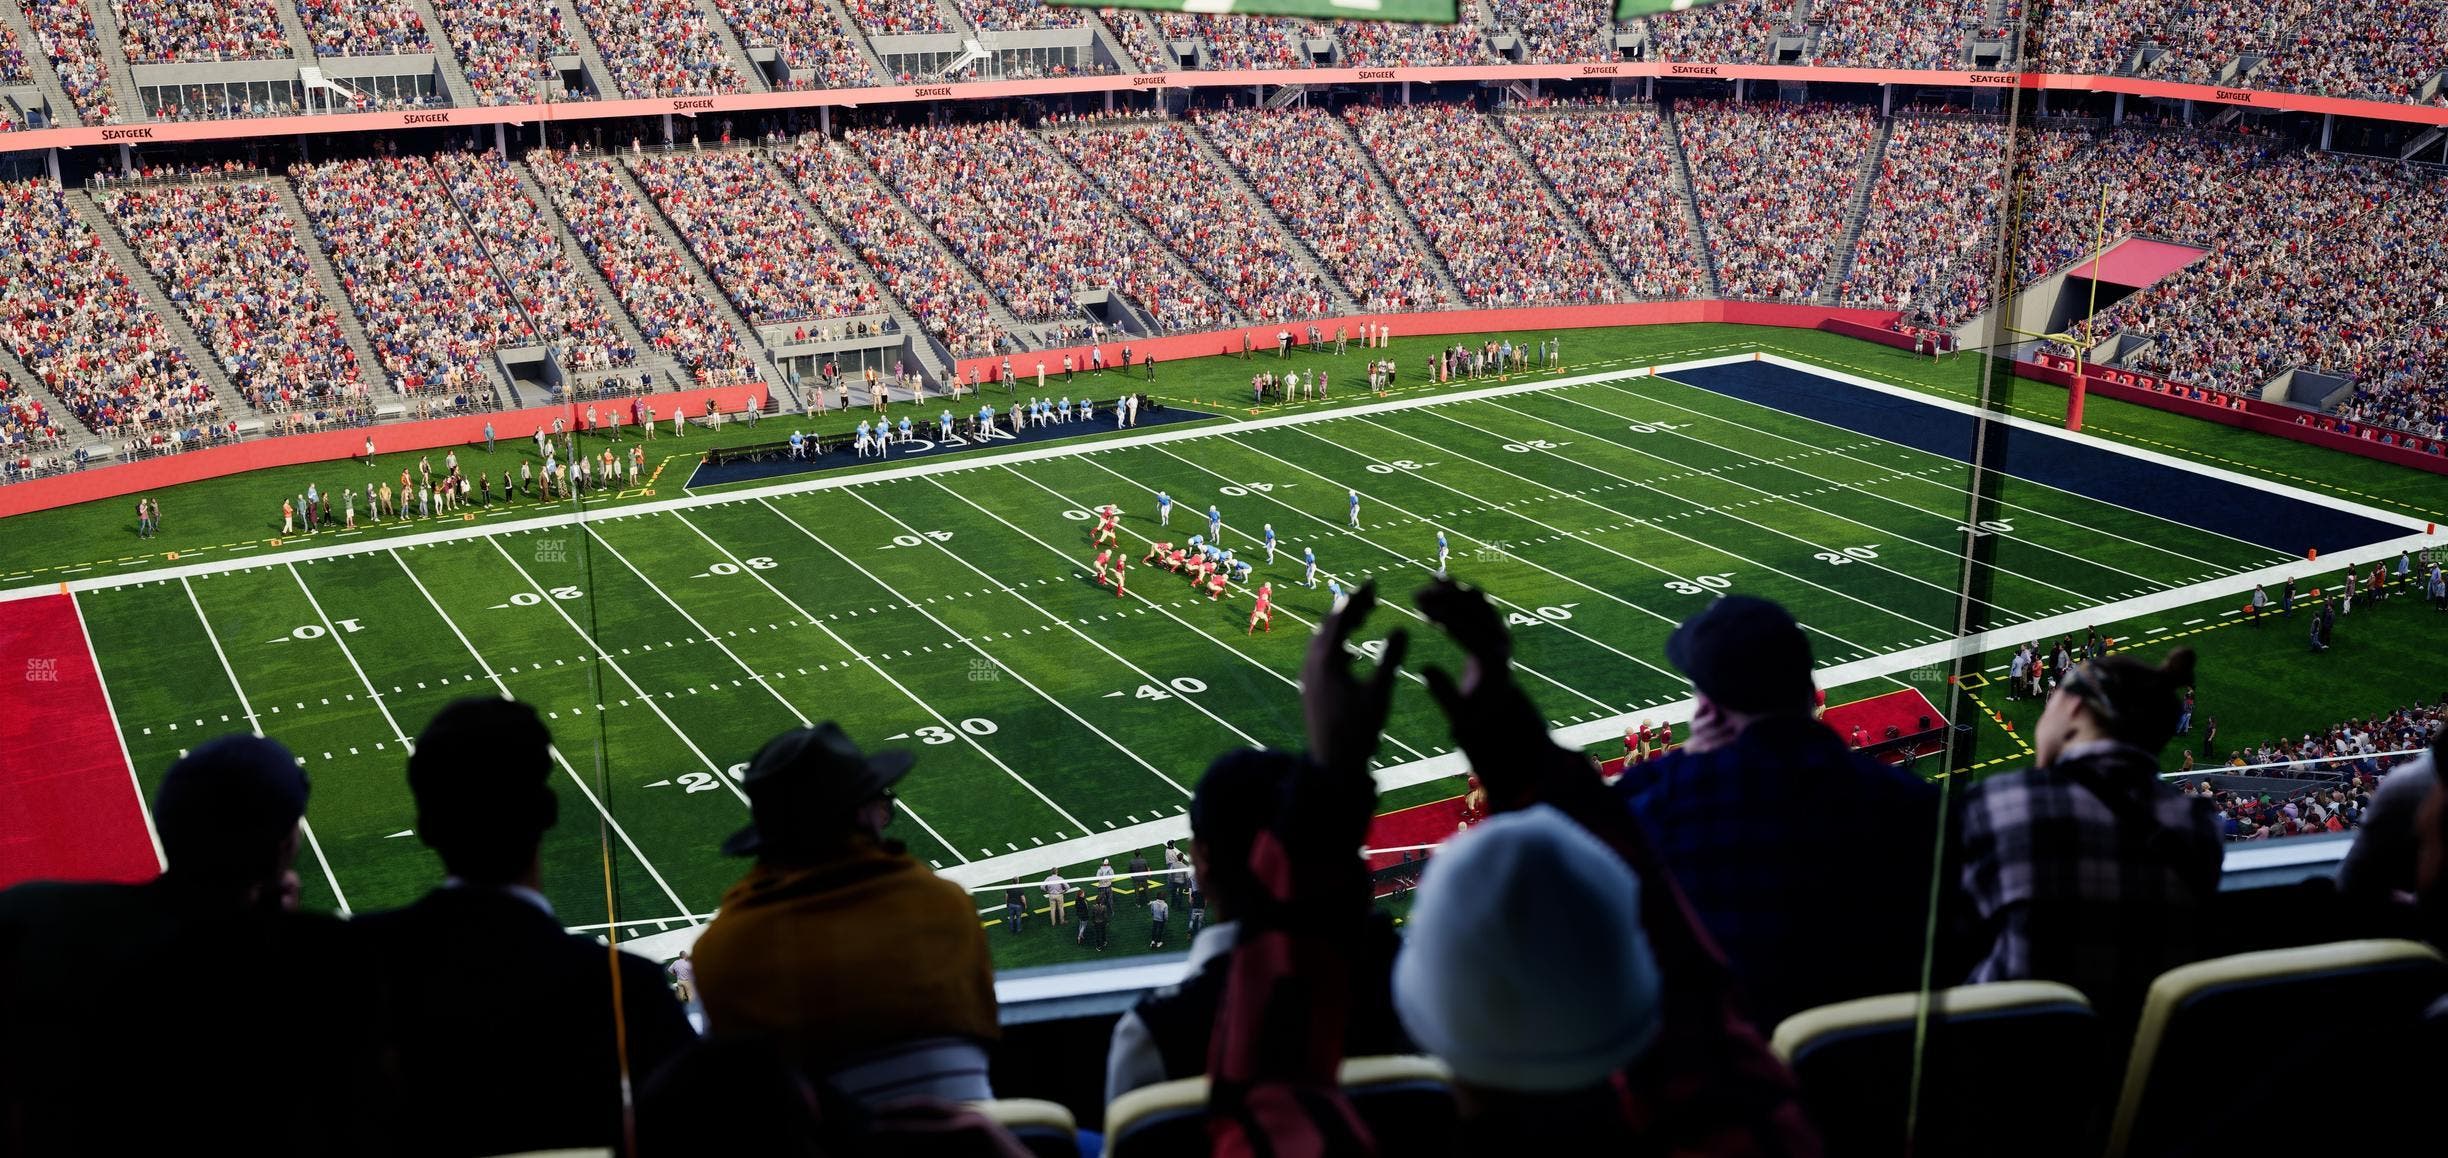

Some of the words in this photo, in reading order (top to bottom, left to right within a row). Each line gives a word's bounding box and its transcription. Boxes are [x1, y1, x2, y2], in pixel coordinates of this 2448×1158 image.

[1358, 70, 1395, 79] SEATGEEK
[1583, 66, 1617, 74] SEATGEEK
[1672, 65, 1717, 75] SEATGEEK
[1133, 76, 1166, 86] SEATGEEK
[1969, 74, 2019, 84] SEATGEEK
[915, 87, 951, 97] SEATGEEK
[2216, 90, 2251, 102] SEATGEEK
[673, 99, 714, 110] SEATGEEK
[404, 113, 449, 124] SEATGEEK
[102, 128, 152, 140] SEATGEEK
[1629, 421, 1678, 433] 10
[1502, 439, 1557, 453] 20
[1366, 460, 1423, 474] 30
[1219, 482, 1273, 496] 40
[1956, 521, 2014, 537] 10
[893, 530, 954, 546] 40
[1814, 547, 1878, 565] 20
[709, 557, 778, 575] 30
[1664, 575, 1732, 595] 30
[510, 585, 583, 606] 20
[1504, 606, 1572, 627] 40
[292, 618, 365, 639] 10
[1135, 677, 1207, 700] 40
[914, 718, 998, 744] 30
